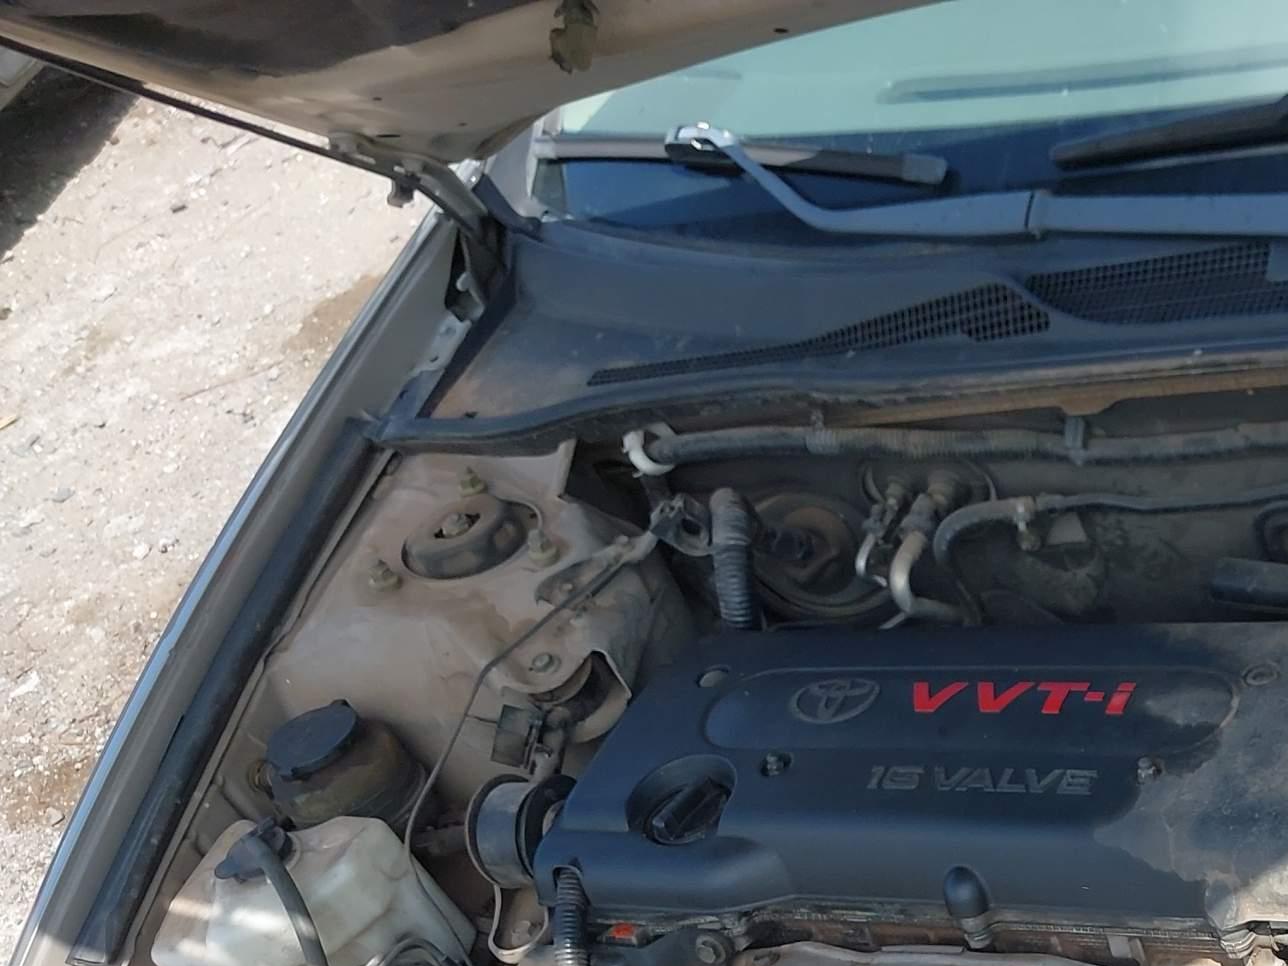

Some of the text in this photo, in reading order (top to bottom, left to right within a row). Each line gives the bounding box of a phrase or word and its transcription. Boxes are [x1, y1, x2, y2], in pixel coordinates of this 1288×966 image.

[913, 682, 1136, 714] VVT-i
[866, 766, 1098, 795] 16 VALVE
